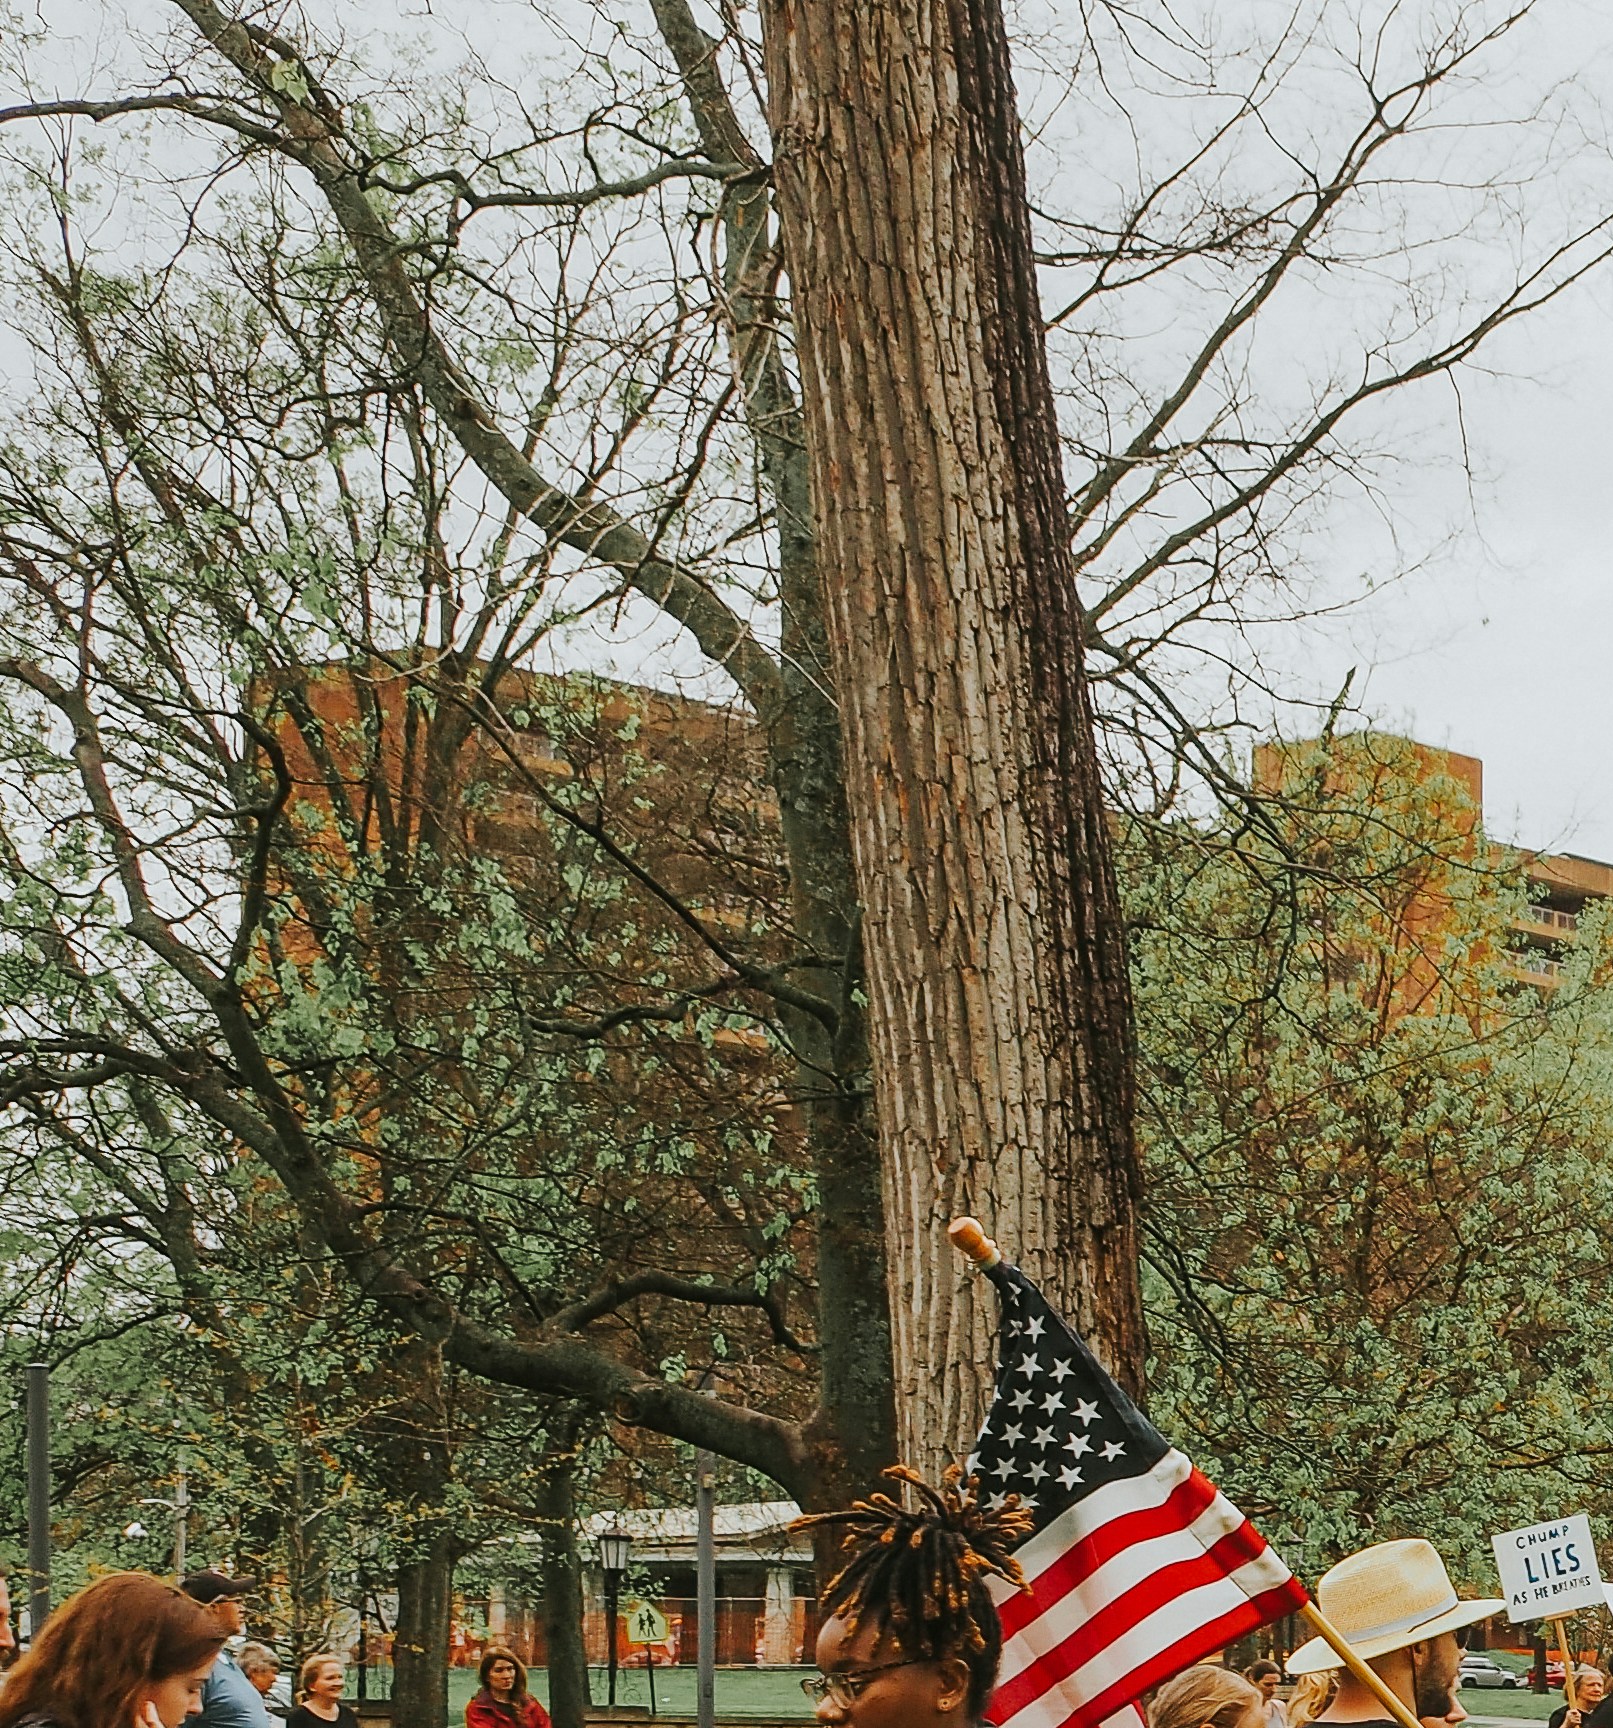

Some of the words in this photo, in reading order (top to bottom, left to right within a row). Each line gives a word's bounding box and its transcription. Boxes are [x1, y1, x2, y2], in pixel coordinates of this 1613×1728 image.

[1515, 1524, 1569, 1549] CHUMP
[1524, 1543, 1581, 1584] LIES
[1512, 1590, 1528, 1605] AS
[1534, 1585, 1548, 1600] HE
